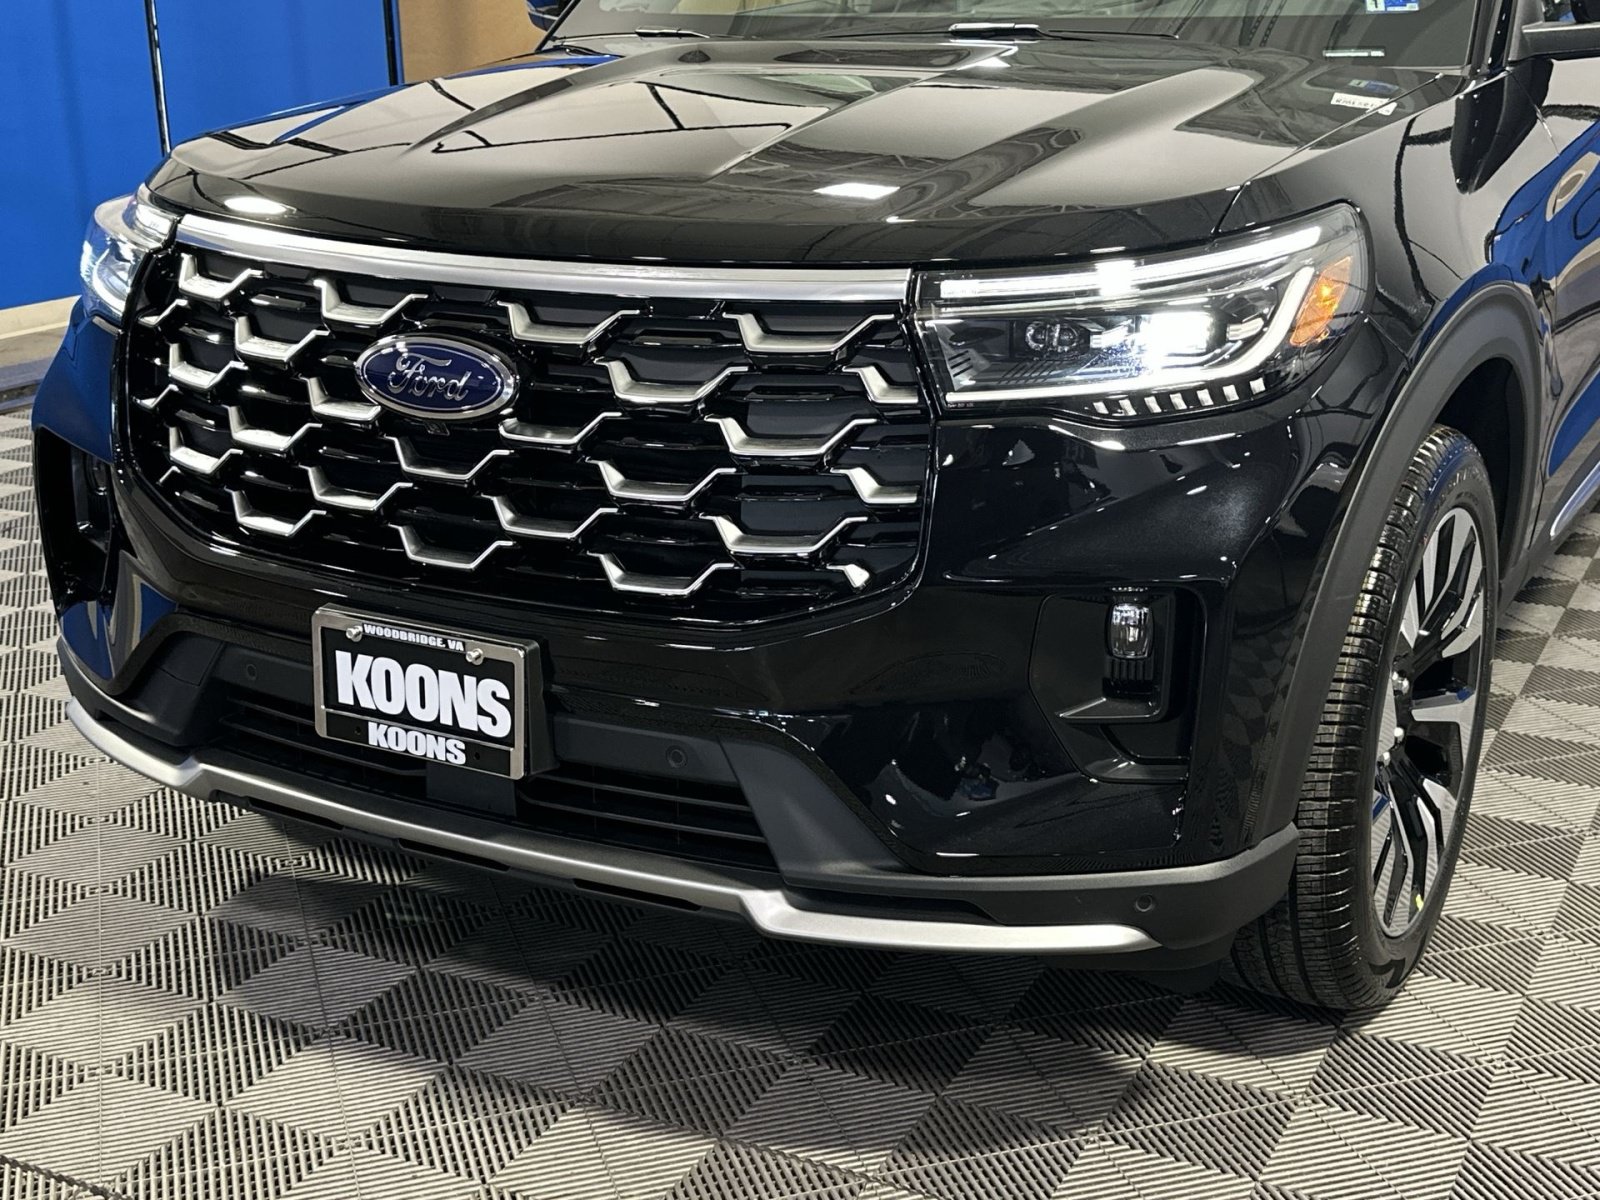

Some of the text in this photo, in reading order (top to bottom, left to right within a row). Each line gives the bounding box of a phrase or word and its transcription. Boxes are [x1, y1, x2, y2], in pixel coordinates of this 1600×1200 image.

[387, 353, 472, 402] Ford
[447, 639, 465, 652] VA
[335, 650, 511, 738] KOONS
[368, 722, 466, 766] KOONS
